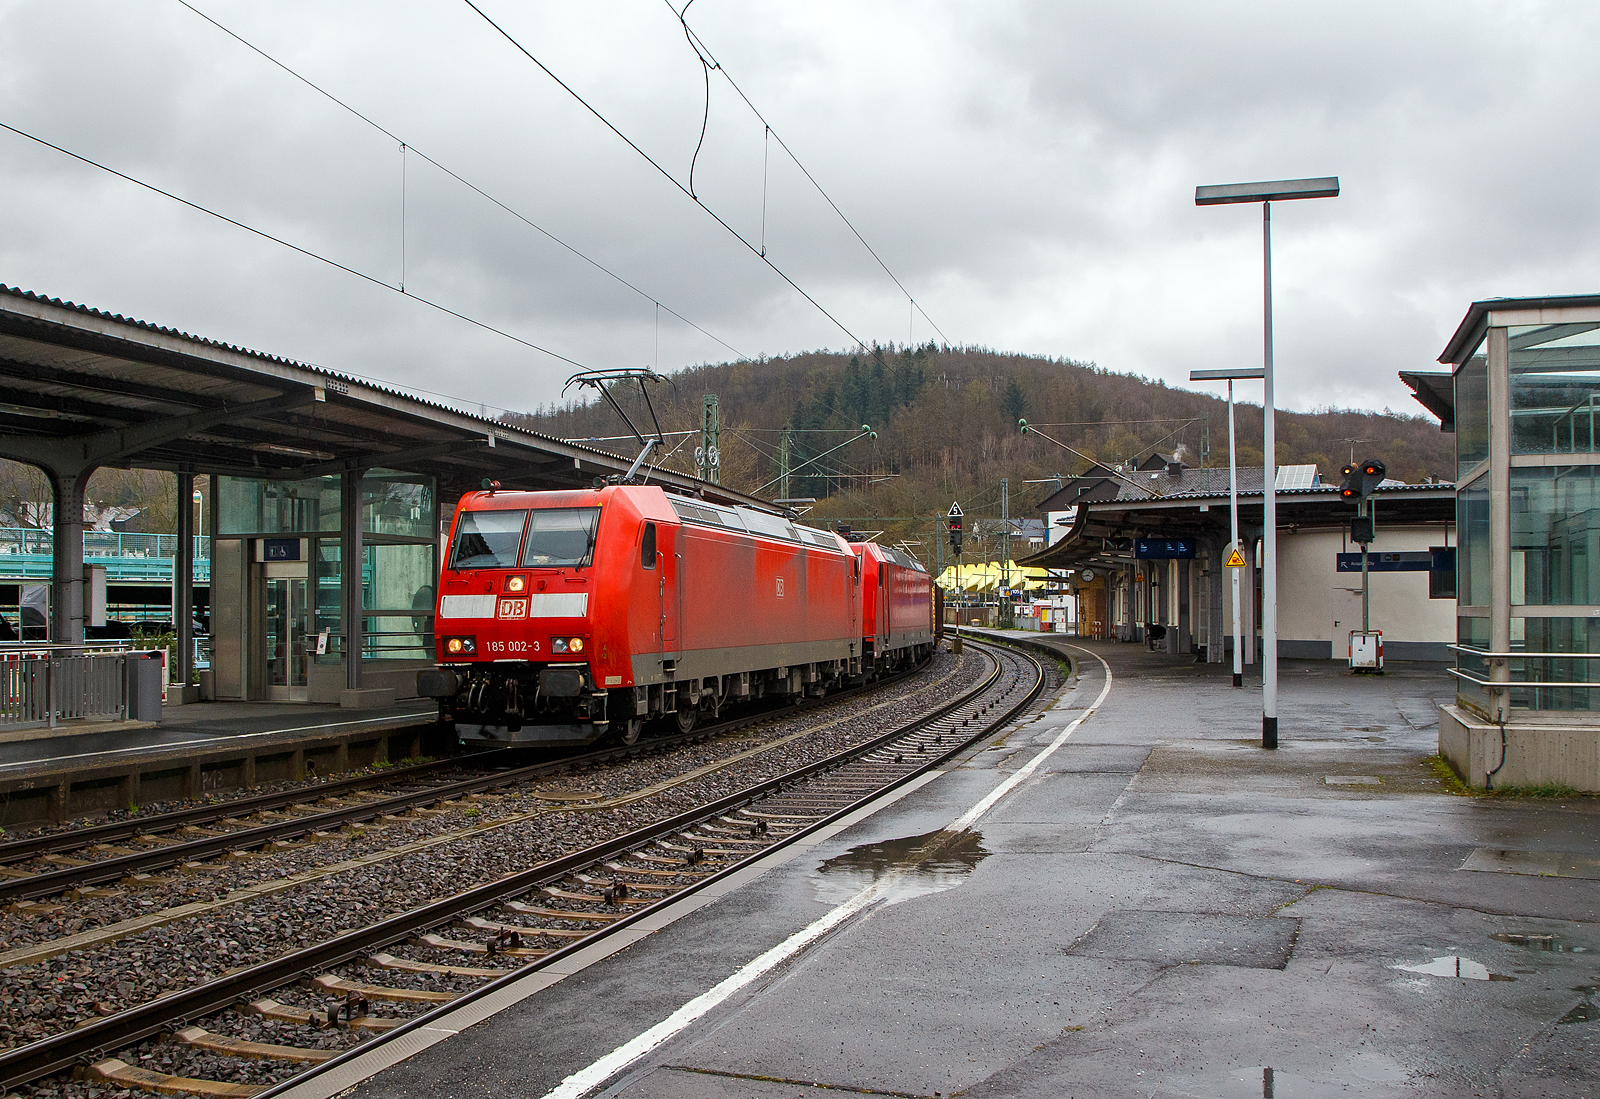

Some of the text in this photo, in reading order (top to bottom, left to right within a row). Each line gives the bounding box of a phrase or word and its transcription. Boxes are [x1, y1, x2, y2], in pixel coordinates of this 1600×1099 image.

[953, 506, 958, 515] 5
[777, 579, 784, 596] DB
[501, 601, 524, 616] DB
[486, 641, 540, 652] 185 002-3
